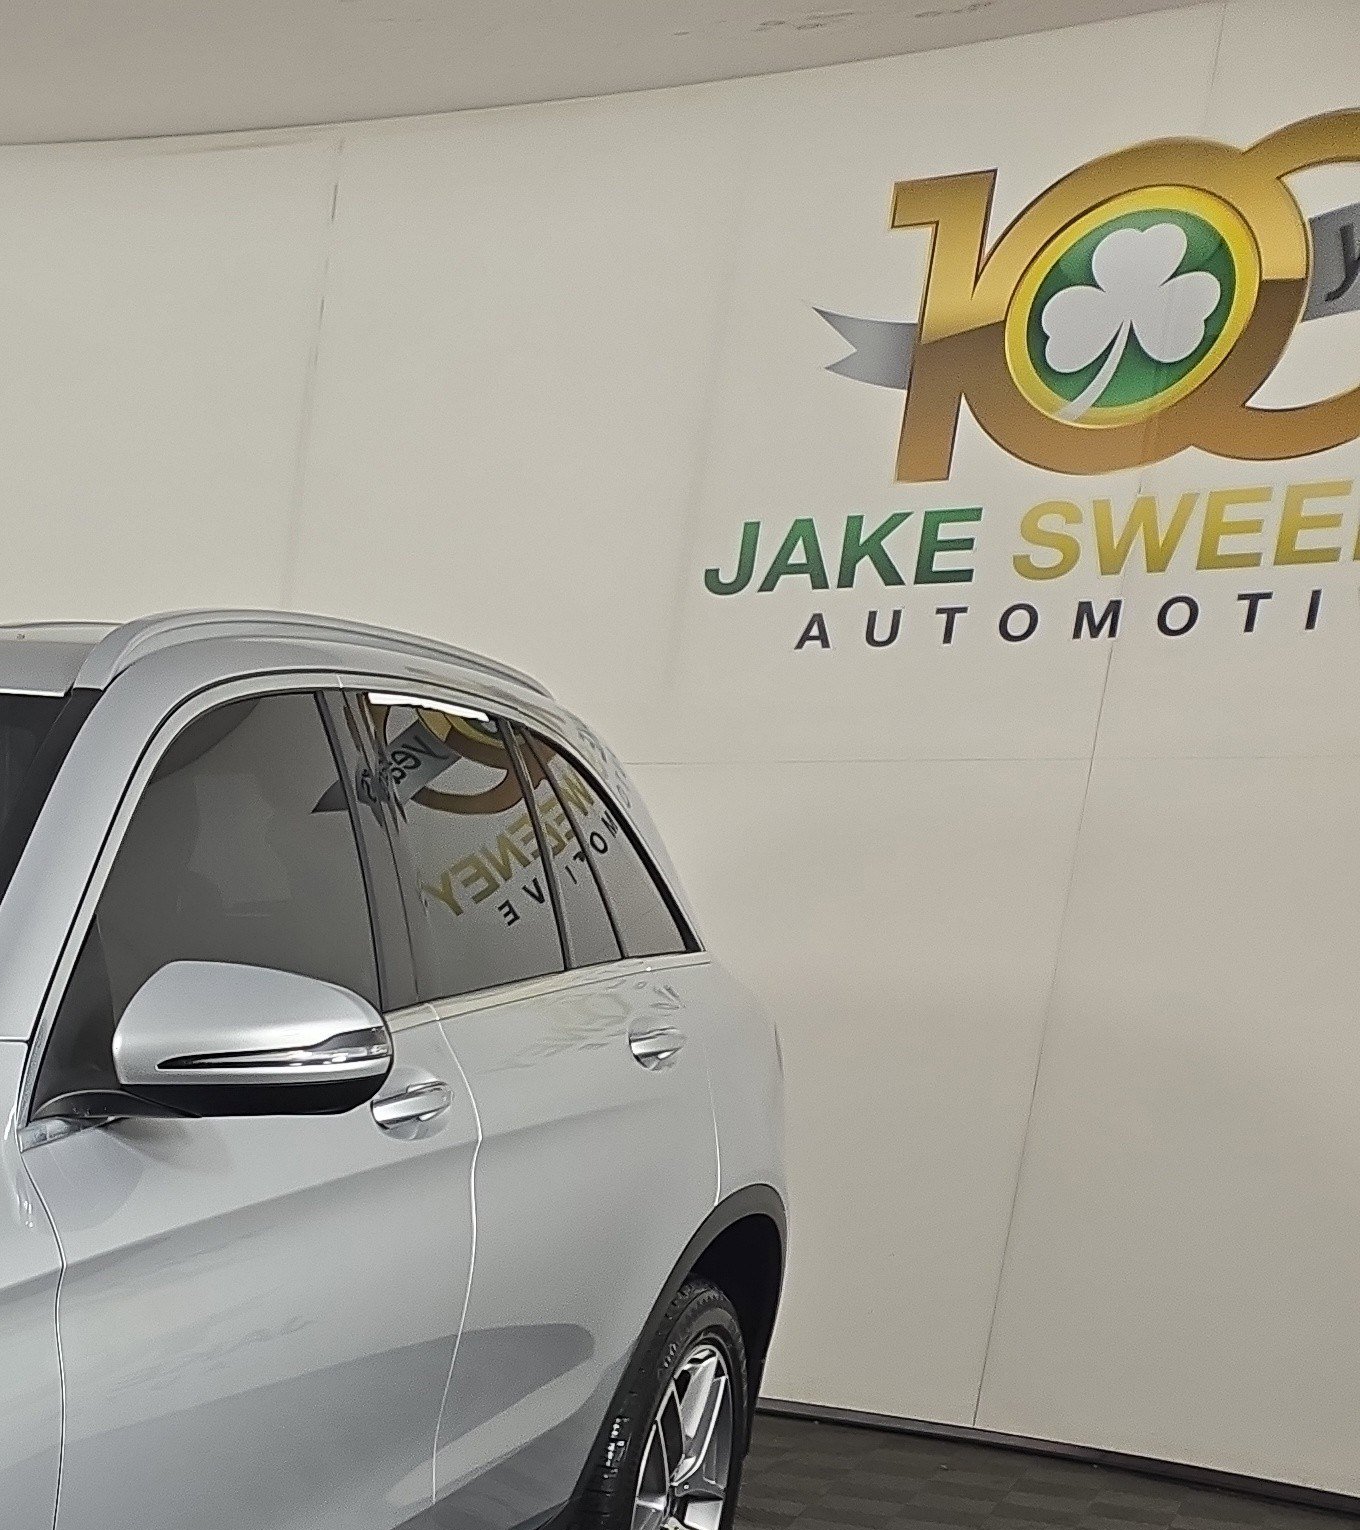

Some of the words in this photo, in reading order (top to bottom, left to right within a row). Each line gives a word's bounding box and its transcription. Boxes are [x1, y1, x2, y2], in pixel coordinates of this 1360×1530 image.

[704, 506, 983, 596] JAKE
[1011, 480, 1360, 581] SWEE
[794, 589, 1322, 651] AUTOMOTI
